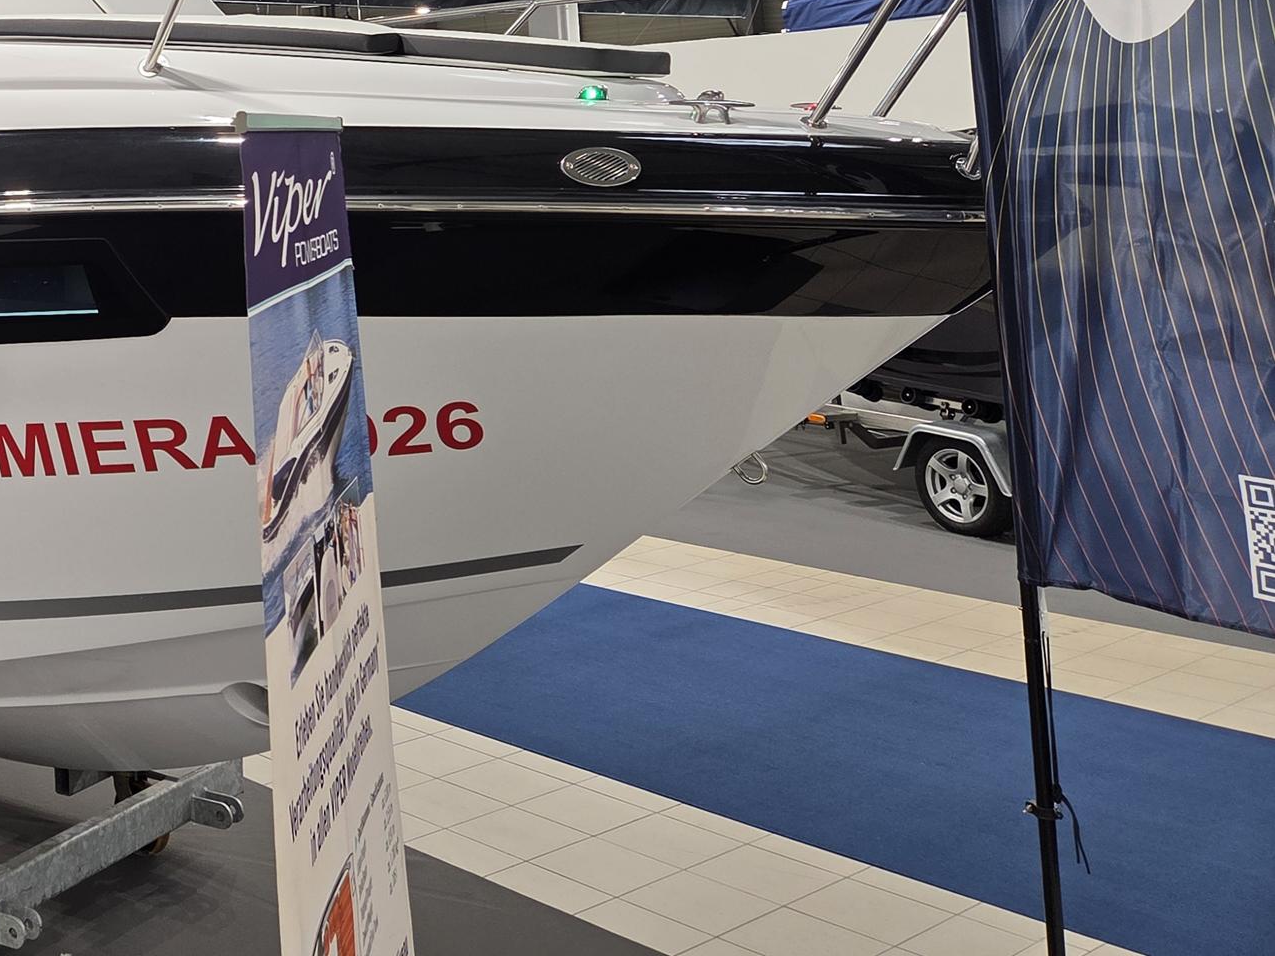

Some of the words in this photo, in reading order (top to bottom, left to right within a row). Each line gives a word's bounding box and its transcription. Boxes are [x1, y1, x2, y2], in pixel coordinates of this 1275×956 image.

[251, 169, 333, 268] Viper
[294, 700, 317, 761] Erleben
[315, 679, 326, 722] Sie
[309, 827, 318, 868] in
[317, 802, 332, 852] allen
[329, 763, 348, 822] VIPER
